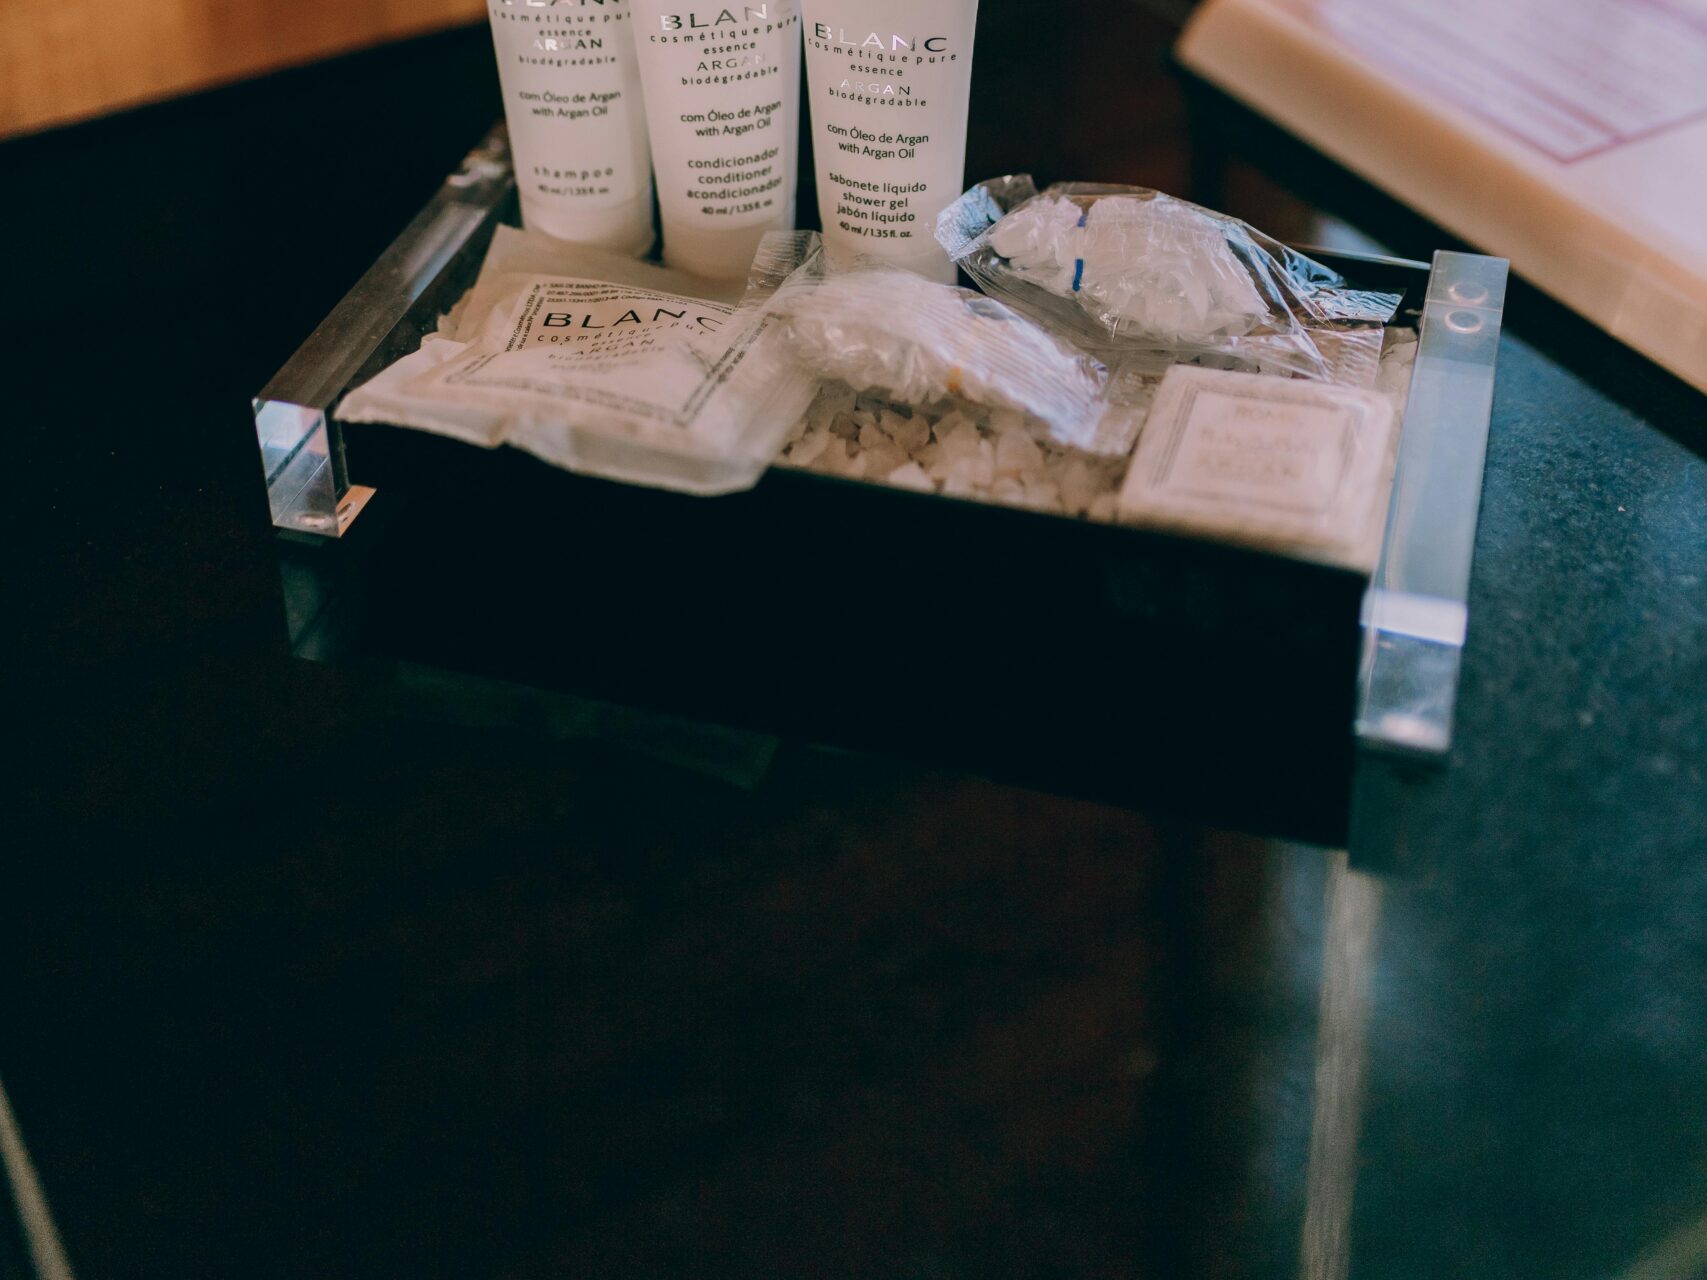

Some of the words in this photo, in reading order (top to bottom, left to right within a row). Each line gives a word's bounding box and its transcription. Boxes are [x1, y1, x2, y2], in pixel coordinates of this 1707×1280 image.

[532, 38, 602, 52] ARGAN
[815, 22, 948, 53] BLANC
[704, 42, 757, 54] essence
[518, 55, 617, 68] biodégradable
[697, 53, 766, 72] ARGAN
[850, 63, 903, 76] essence
[682, 66, 778, 86] biodégradable
[519, 91, 541, 102] com
[543, 89, 570, 104] Óleo
[572, 93, 586, 104] de
[588, 91, 621, 103] Argan
[829, 87, 926, 107] biodégradable
[840, 79, 910, 96] ARGAN
[532, 106, 554, 118] with
[557, 108, 590, 120] Argan
[592, 106, 608, 116] Oil
[680, 114, 704, 122] com
[708, 110, 735, 122] Óleo
[738, 108, 750, 118] de
[754, 100, 782, 116] Argan
[696, 126, 720, 136] with
[722, 123, 754, 136] Argan
[757, 117, 771, 130] Oil
[828, 124, 848, 136] com
[850, 126, 876, 142] Óleo
[878, 132, 893, 144] de
[896, 134, 929, 146] Argan
[688, 147, 779, 168] condicionador
[838, 142, 860, 154] with
[862, 146, 895, 160] Argan
[898, 148, 915, 158] Oil
[698, 166, 772, 184] conditioner
[829, 172, 880, 192] sabonete
[883, 182, 927, 196] líquido
[687, 176, 782, 200] acondicionador
[843, 192, 886, 208] shower
[890, 198, 908, 210] gel
[837, 204, 868, 220] jabón
[872, 211, 916, 224] líquido
[840, 221, 850, 230] 40
[851, 226, 862, 234] ml
[864, 227, 868, 236] /
[543, 308, 725, 332] BLANC
